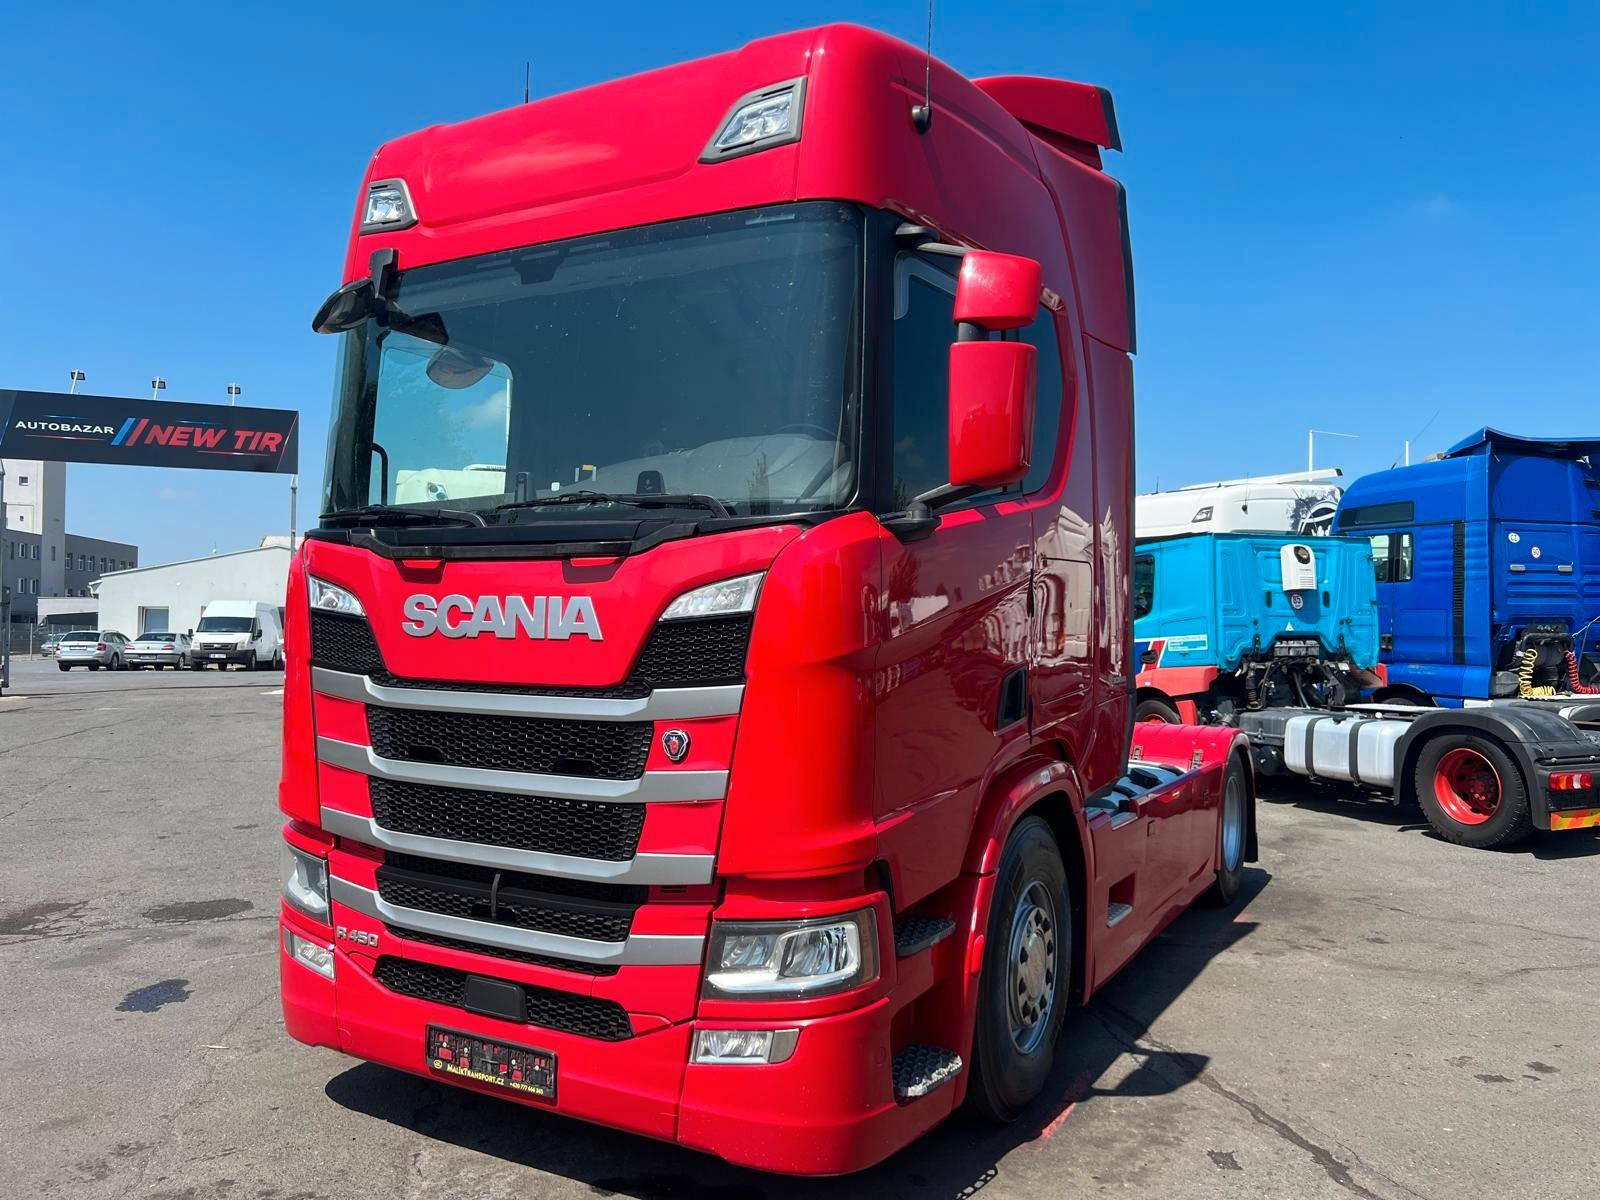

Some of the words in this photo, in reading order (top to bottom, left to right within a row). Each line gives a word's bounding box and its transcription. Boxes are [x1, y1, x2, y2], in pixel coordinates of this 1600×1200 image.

[15, 420, 114, 434] AUTOBAZAR
[144, 425, 227, 448] NEW
[233, 430, 284, 452] TIR
[402, 594, 604, 641] SCANIA
[336, 926, 347, 939] R
[349, 930, 379, 947] 450
